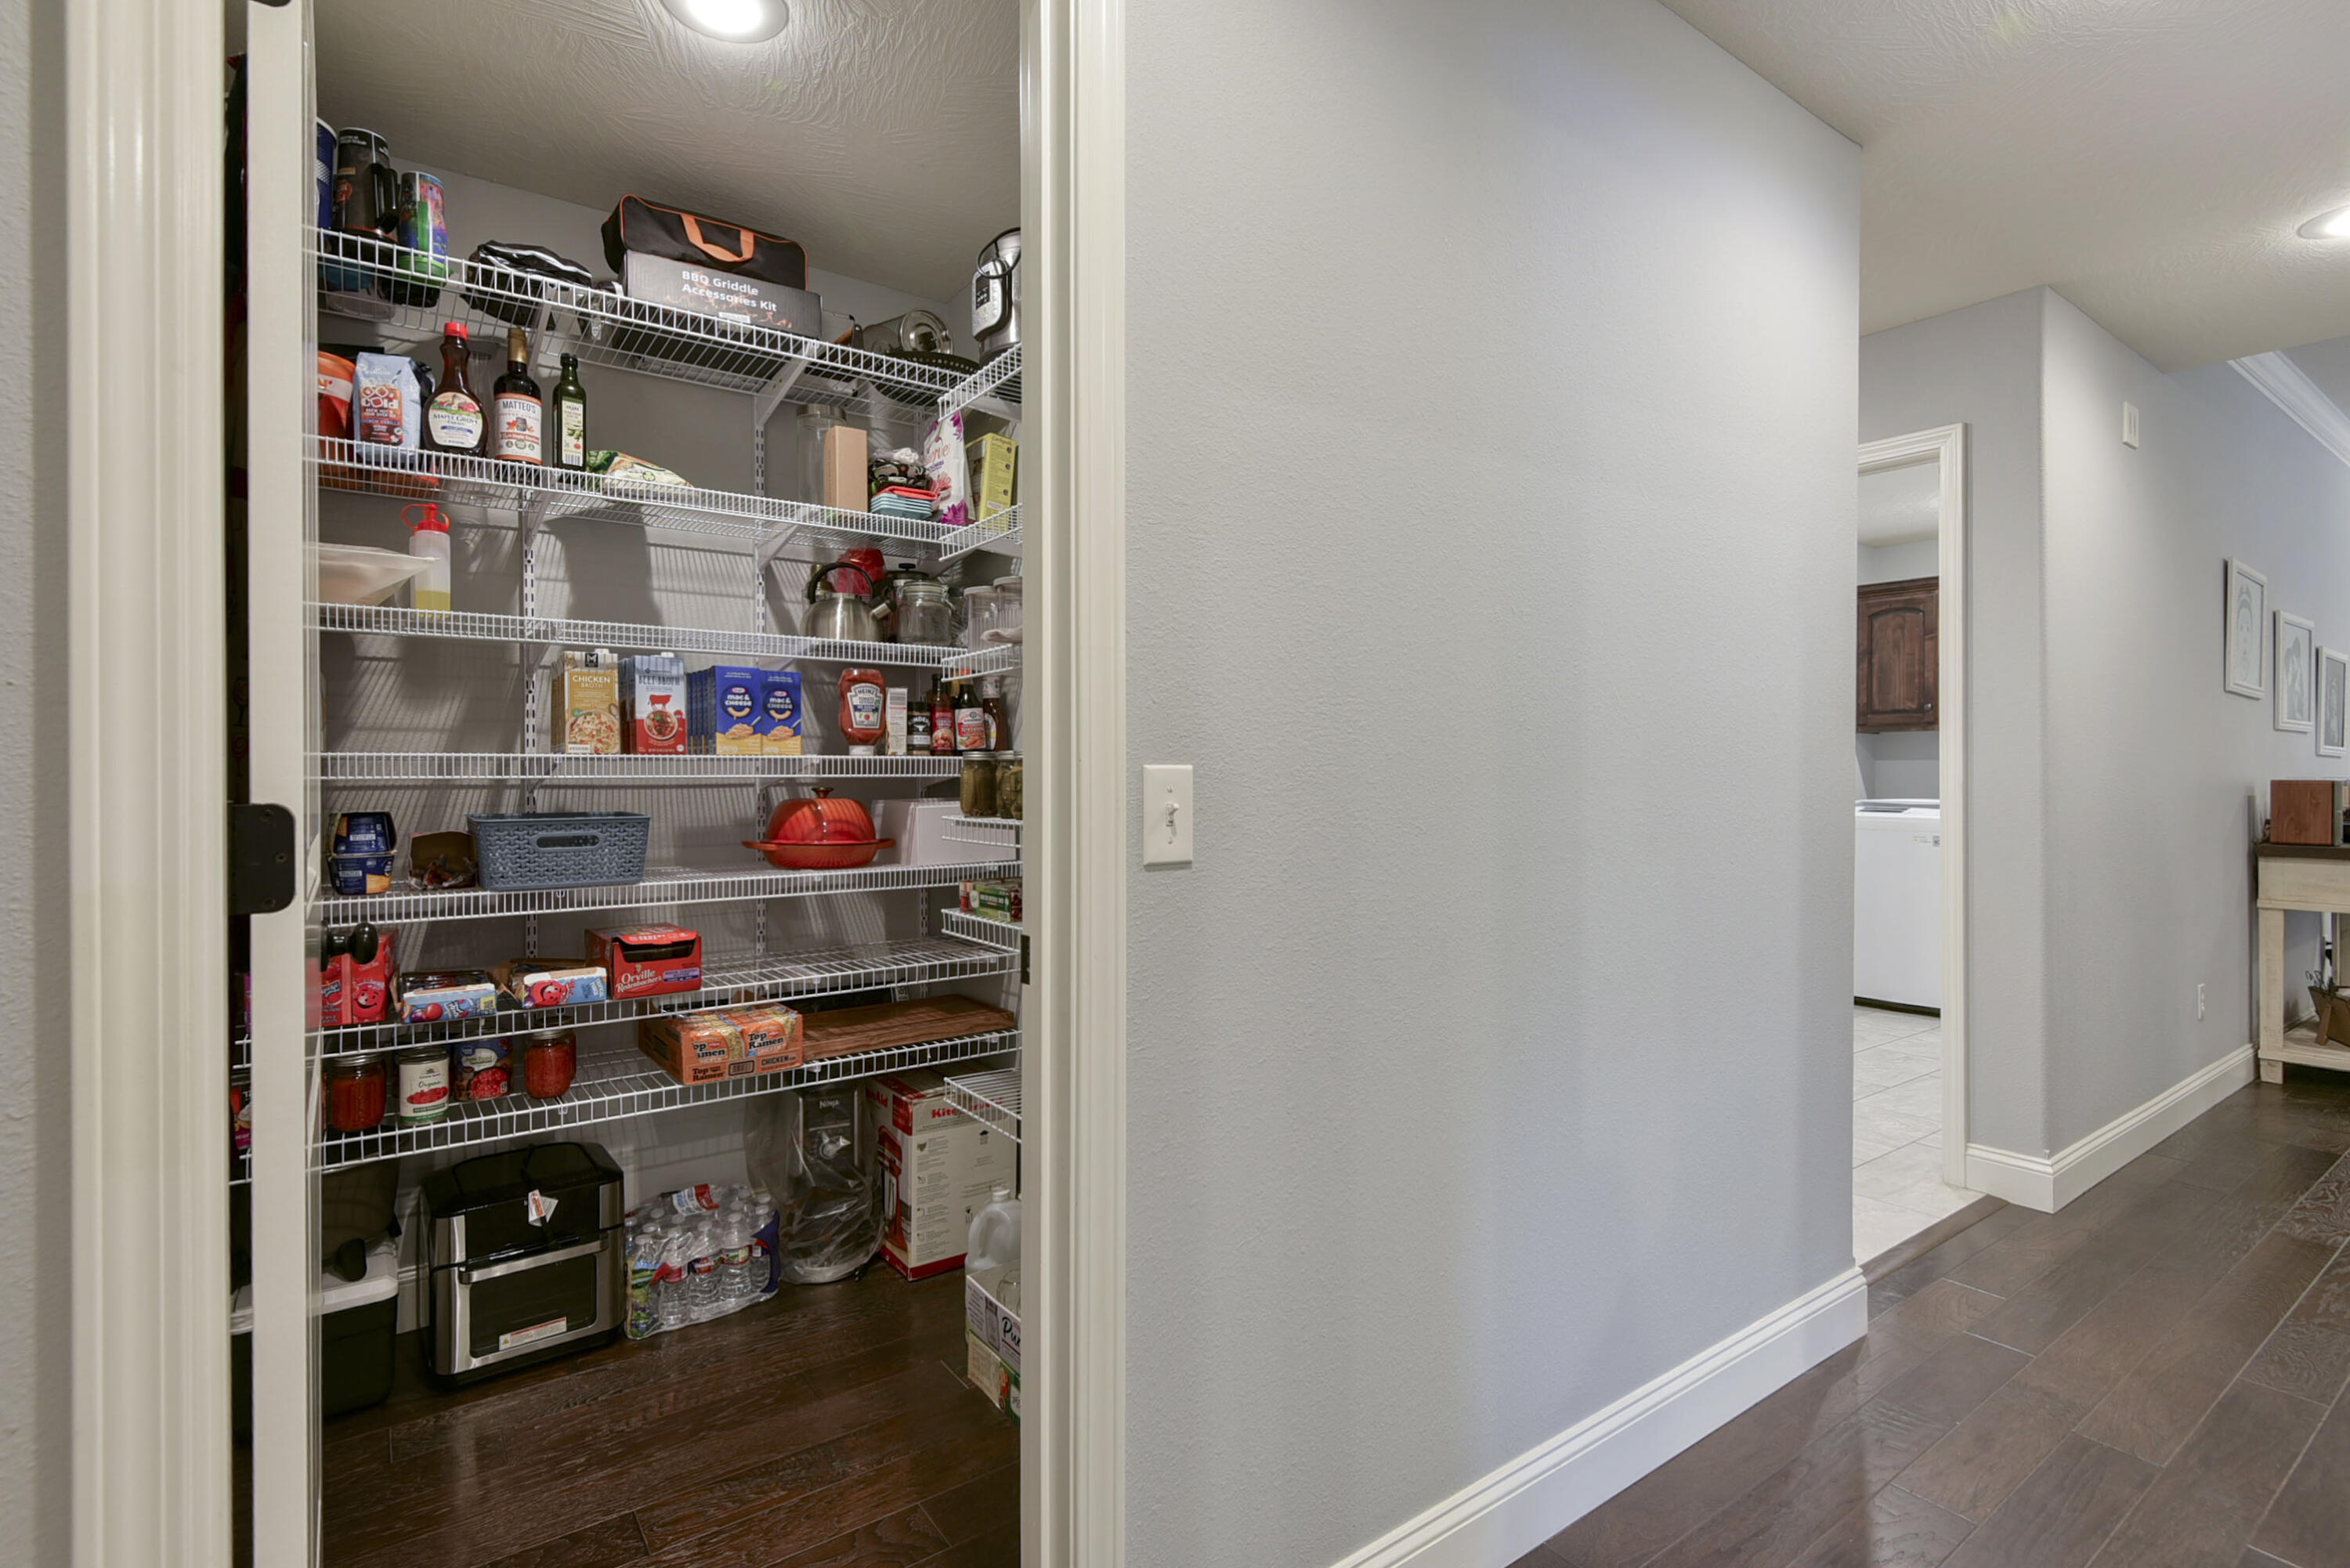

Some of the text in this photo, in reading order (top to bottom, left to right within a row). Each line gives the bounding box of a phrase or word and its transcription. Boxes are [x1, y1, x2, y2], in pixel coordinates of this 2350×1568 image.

[682, 271, 758, 296] BBQ Griddle
[682, 284, 777, 312] Accessories Kit
[502, 400, 536, 414] MATTEO'S
[573, 674, 611, 684] CHICKEN
[638, 675, 681, 686] BEEF BROTH
[621, 969, 656, 984] Orville
[616, 976, 662, 993] Redenbacher's
[748, 1032, 768, 1042] Top
[693, 1042, 707, 1052] op
[748, 1036, 784, 1050] Ramen
[761, 1054, 789, 1066] CHICKEN
[692, 1067, 709, 1075] Top
[692, 1072, 725, 1082] Ramen
[819, 1099, 840, 1109] NINJA
